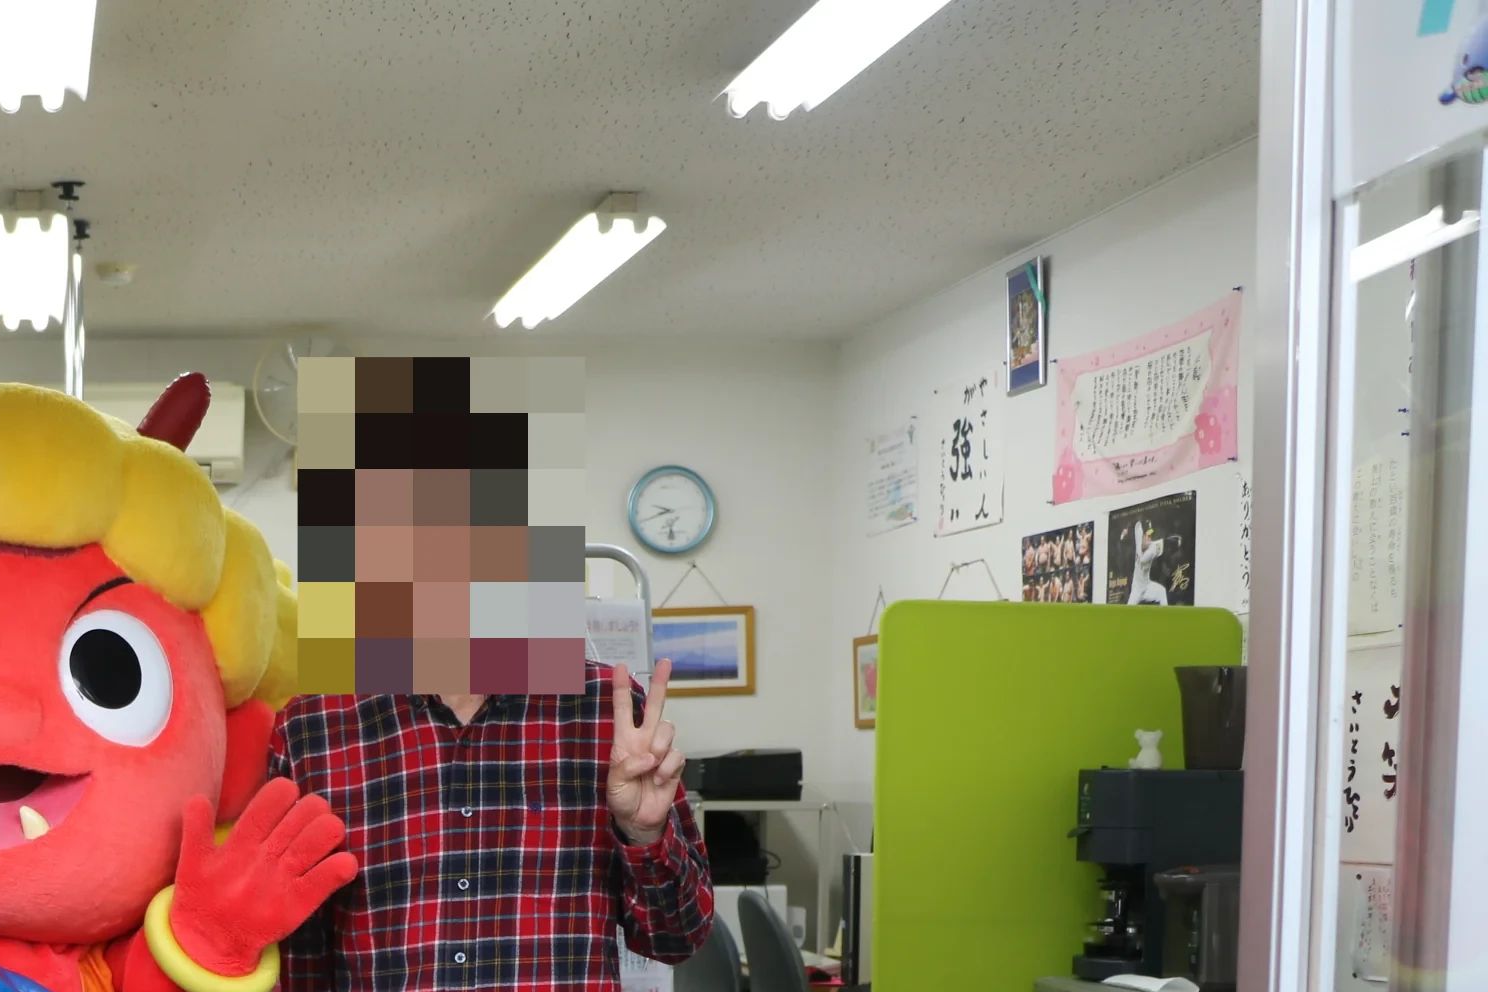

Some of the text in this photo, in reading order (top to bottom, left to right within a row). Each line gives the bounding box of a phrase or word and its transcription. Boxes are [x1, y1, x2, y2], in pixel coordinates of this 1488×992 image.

[974, 376, 990, 521] やさしい人
[1343, 690, 1363, 834] さいとうひとり
